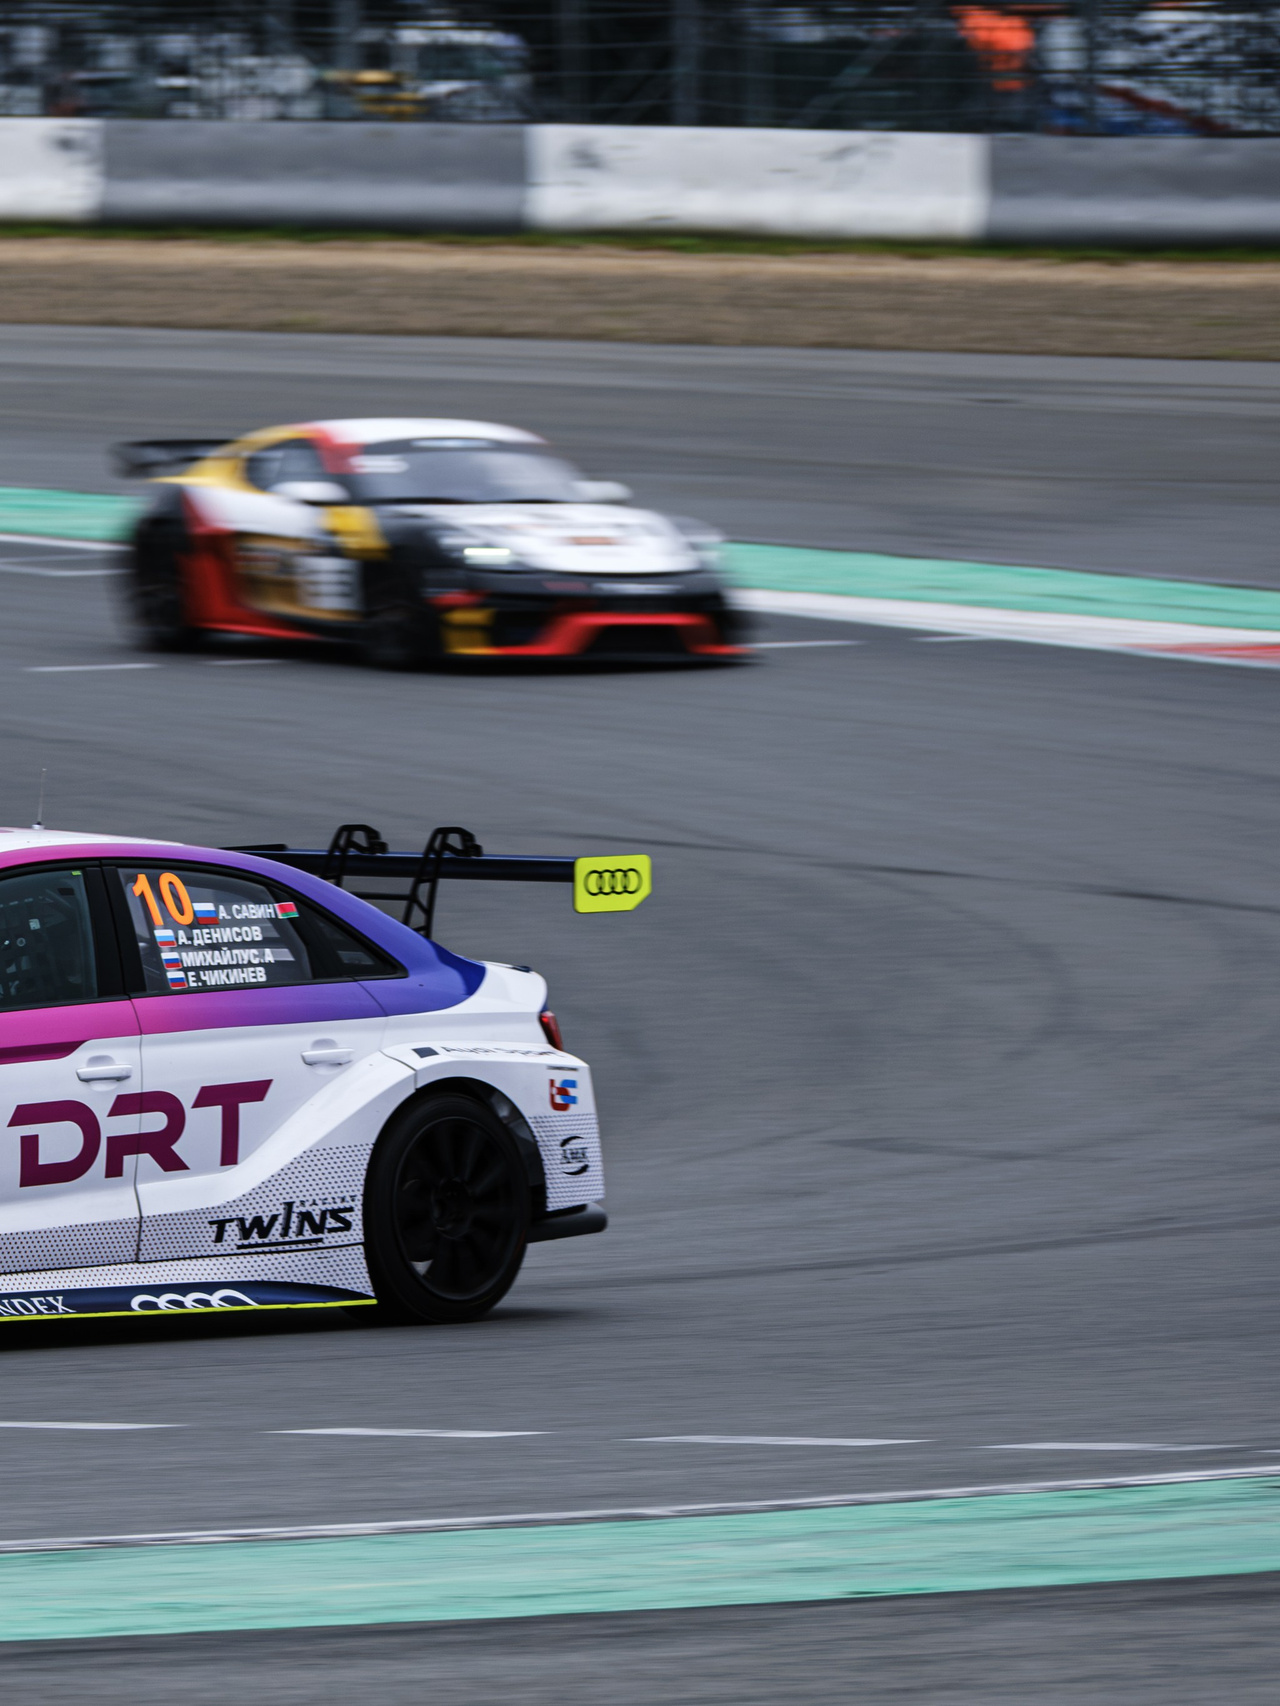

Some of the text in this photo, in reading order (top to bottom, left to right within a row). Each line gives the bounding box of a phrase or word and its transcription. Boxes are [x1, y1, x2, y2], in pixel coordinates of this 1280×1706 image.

[132, 872, 195, 926] 10
[232, 903, 276, 919] САВИН
[7, 1079, 274, 1188] DRT
[208, 1201, 355, 1243] TWINS
